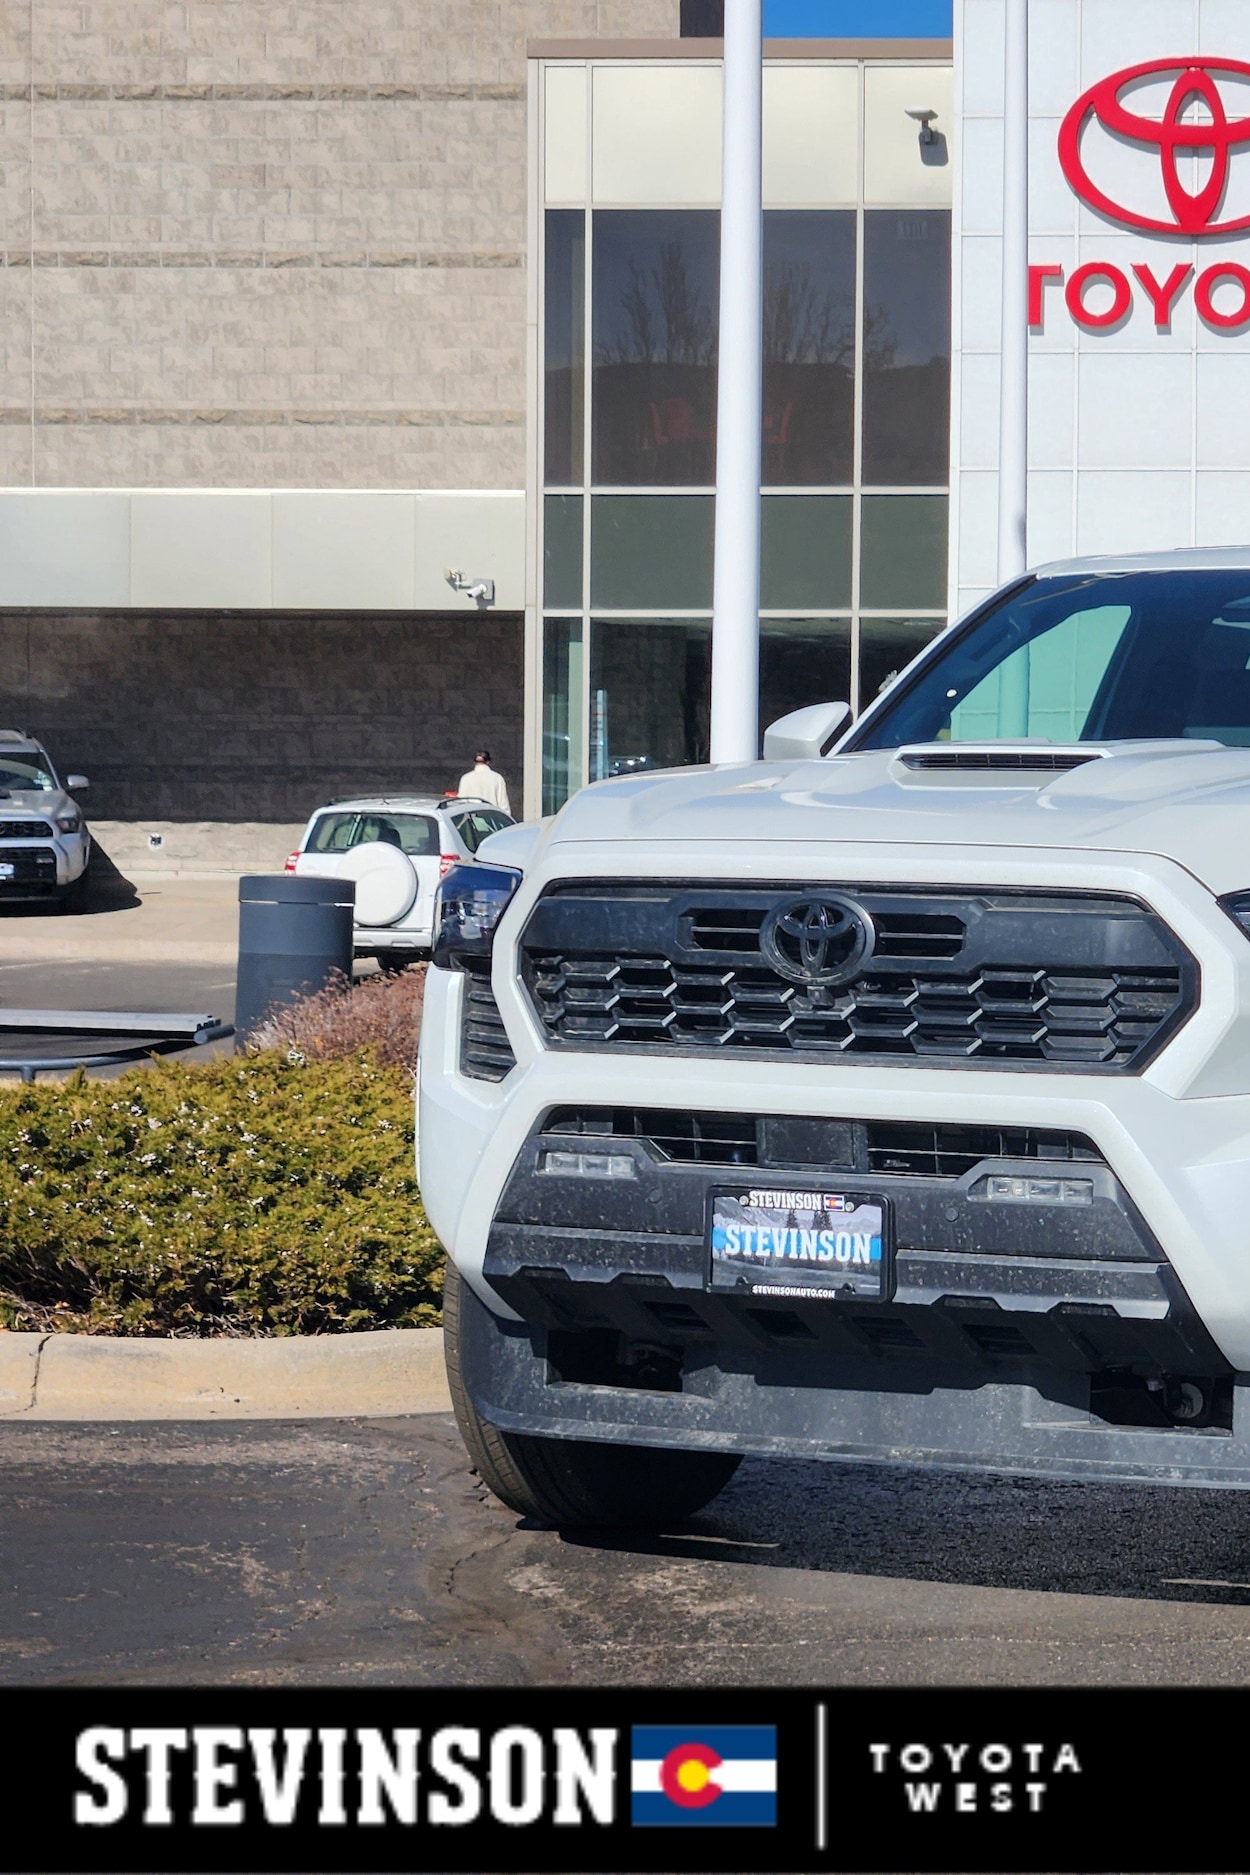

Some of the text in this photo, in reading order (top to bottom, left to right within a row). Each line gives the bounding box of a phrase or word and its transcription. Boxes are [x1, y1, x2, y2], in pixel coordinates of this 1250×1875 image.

[749, 1190, 822, 1211] STEVINSON
[725, 1225, 872, 1264] STEVINSON
[752, 1284, 836, 1298] STEVINSONAUTO.COM
